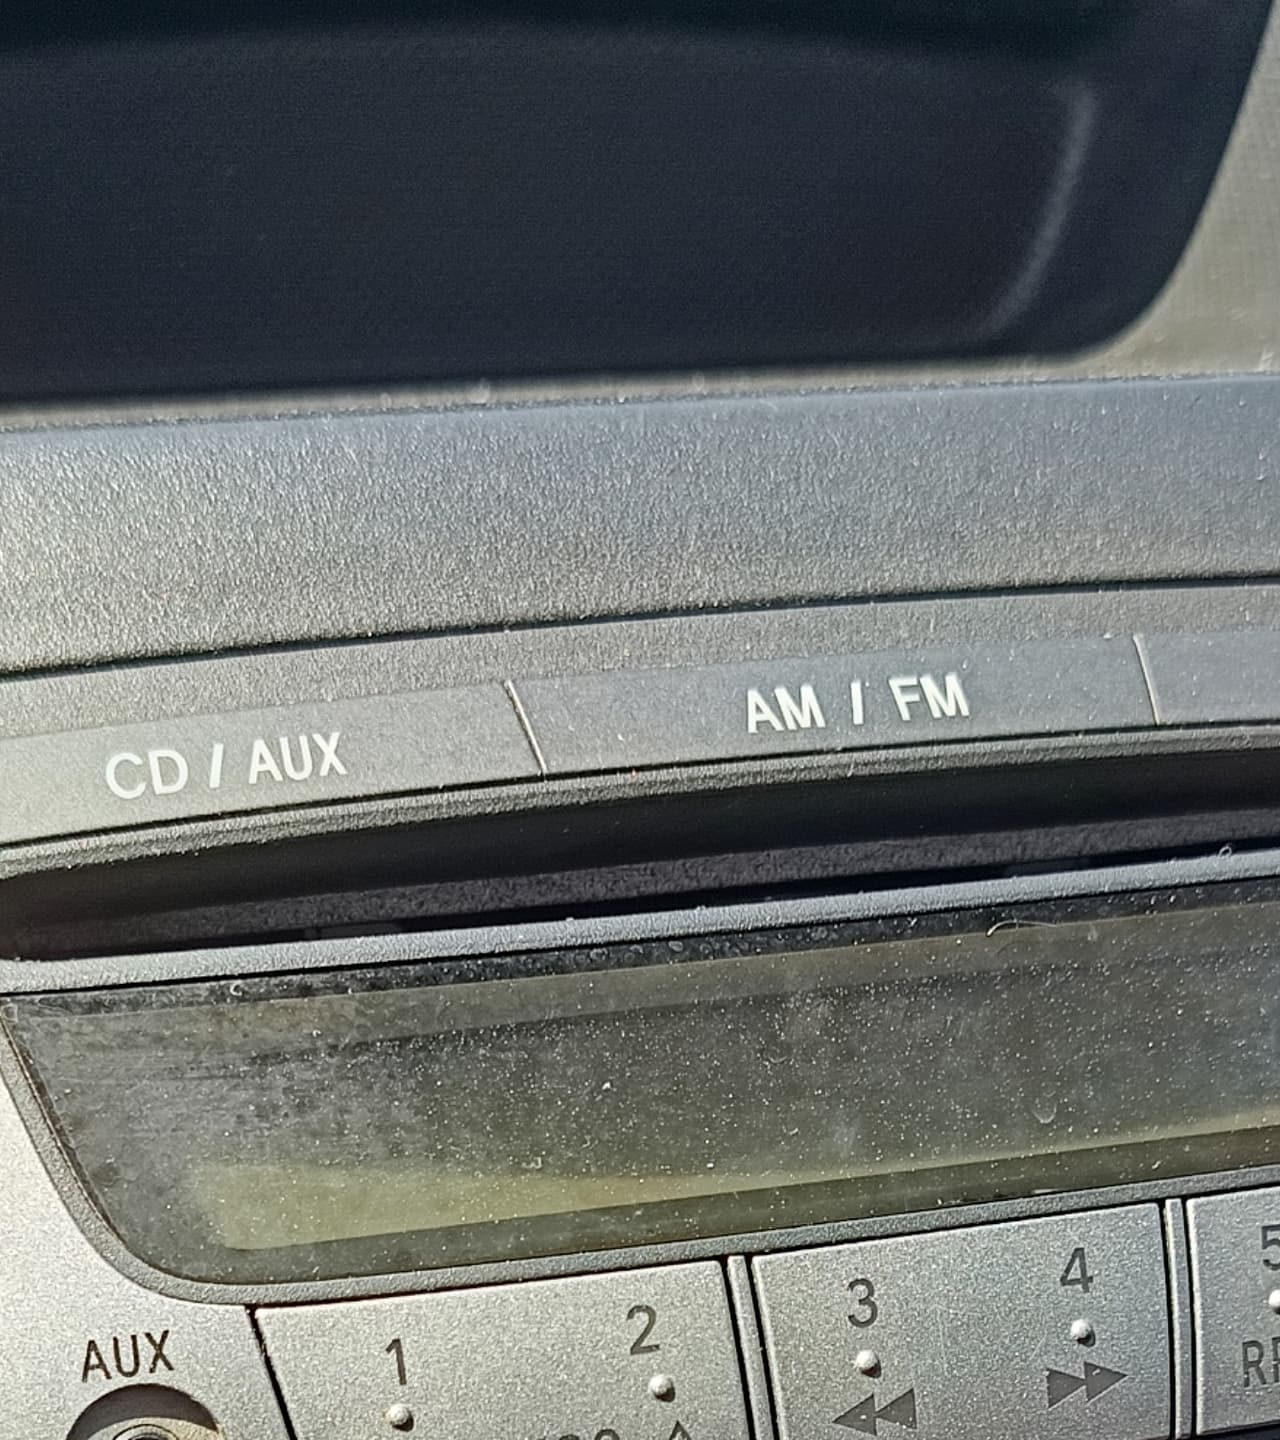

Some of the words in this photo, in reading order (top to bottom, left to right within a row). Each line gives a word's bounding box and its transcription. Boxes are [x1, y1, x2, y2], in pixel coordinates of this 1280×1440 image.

[745, 684, 825, 734] AM
[888, 672, 970, 721] FM
[106, 749, 189, 799] CD
[247, 732, 348, 785] AUX
[1059, 1248, 1094, 1293] 4
[847, 1278, 878, 1328] 3
[626, 1305, 661, 1355] 2
[80, 1330, 175, 1382] AUX
[385, 1338, 407, 1386] 1
